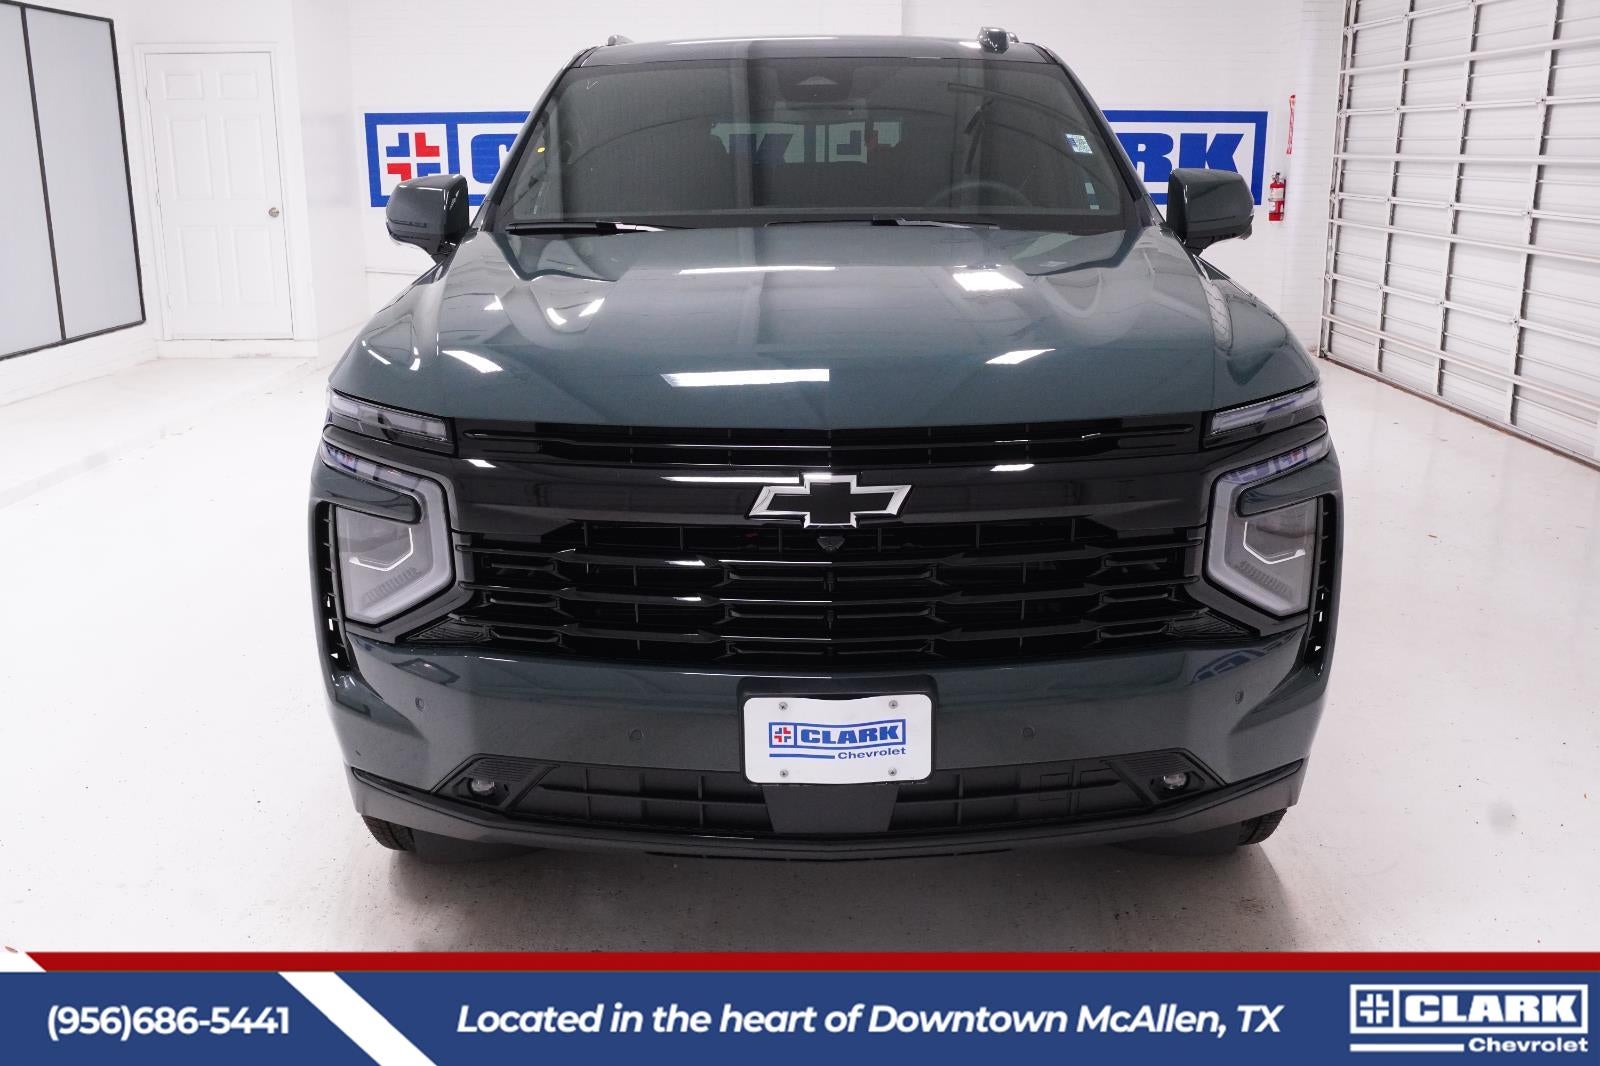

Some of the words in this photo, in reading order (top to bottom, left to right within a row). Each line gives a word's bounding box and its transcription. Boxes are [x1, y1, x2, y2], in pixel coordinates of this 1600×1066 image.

[1106, 132, 1244, 183] RK
[800, 725, 900, 745] CLARK
[837, 746, 907, 761] Chevrolet
